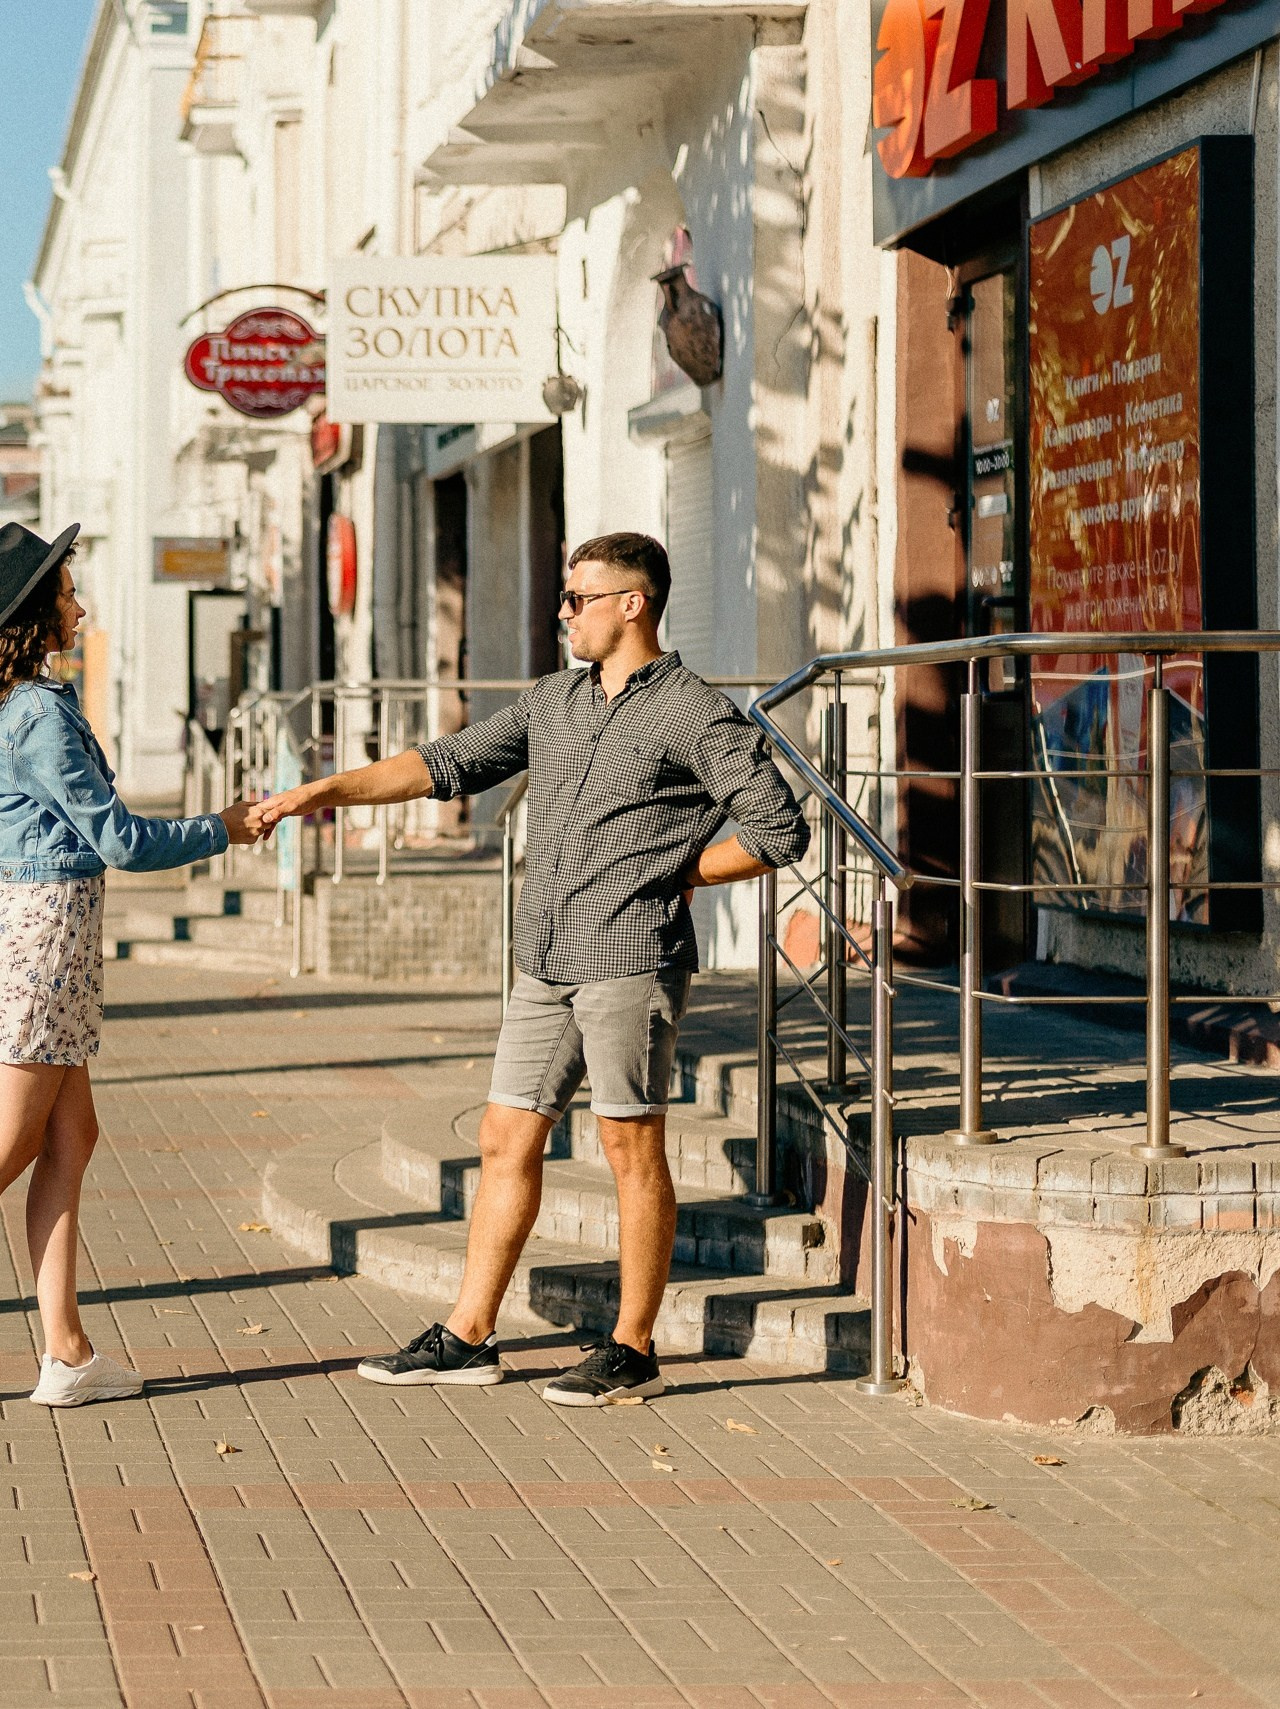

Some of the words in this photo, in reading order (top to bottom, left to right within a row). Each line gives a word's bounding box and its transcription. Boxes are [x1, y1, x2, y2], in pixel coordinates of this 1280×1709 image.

[345, 286, 518, 319] СКУПКА
[209, 338, 303, 361] Пинск
[345, 326, 518, 359] ЗОЛОТА
[1065, 373, 1099, 400] Книги
[1113, 353, 1161, 385] Подарки
[1044, 414, 1112, 449] Канцтовары
[1125, 392, 1183, 426] Косметика
[1043, 459, 1112, 490] Развлечения
[1080, 502, 1119, 526] многое
[1106, 560, 1136, 583] также
